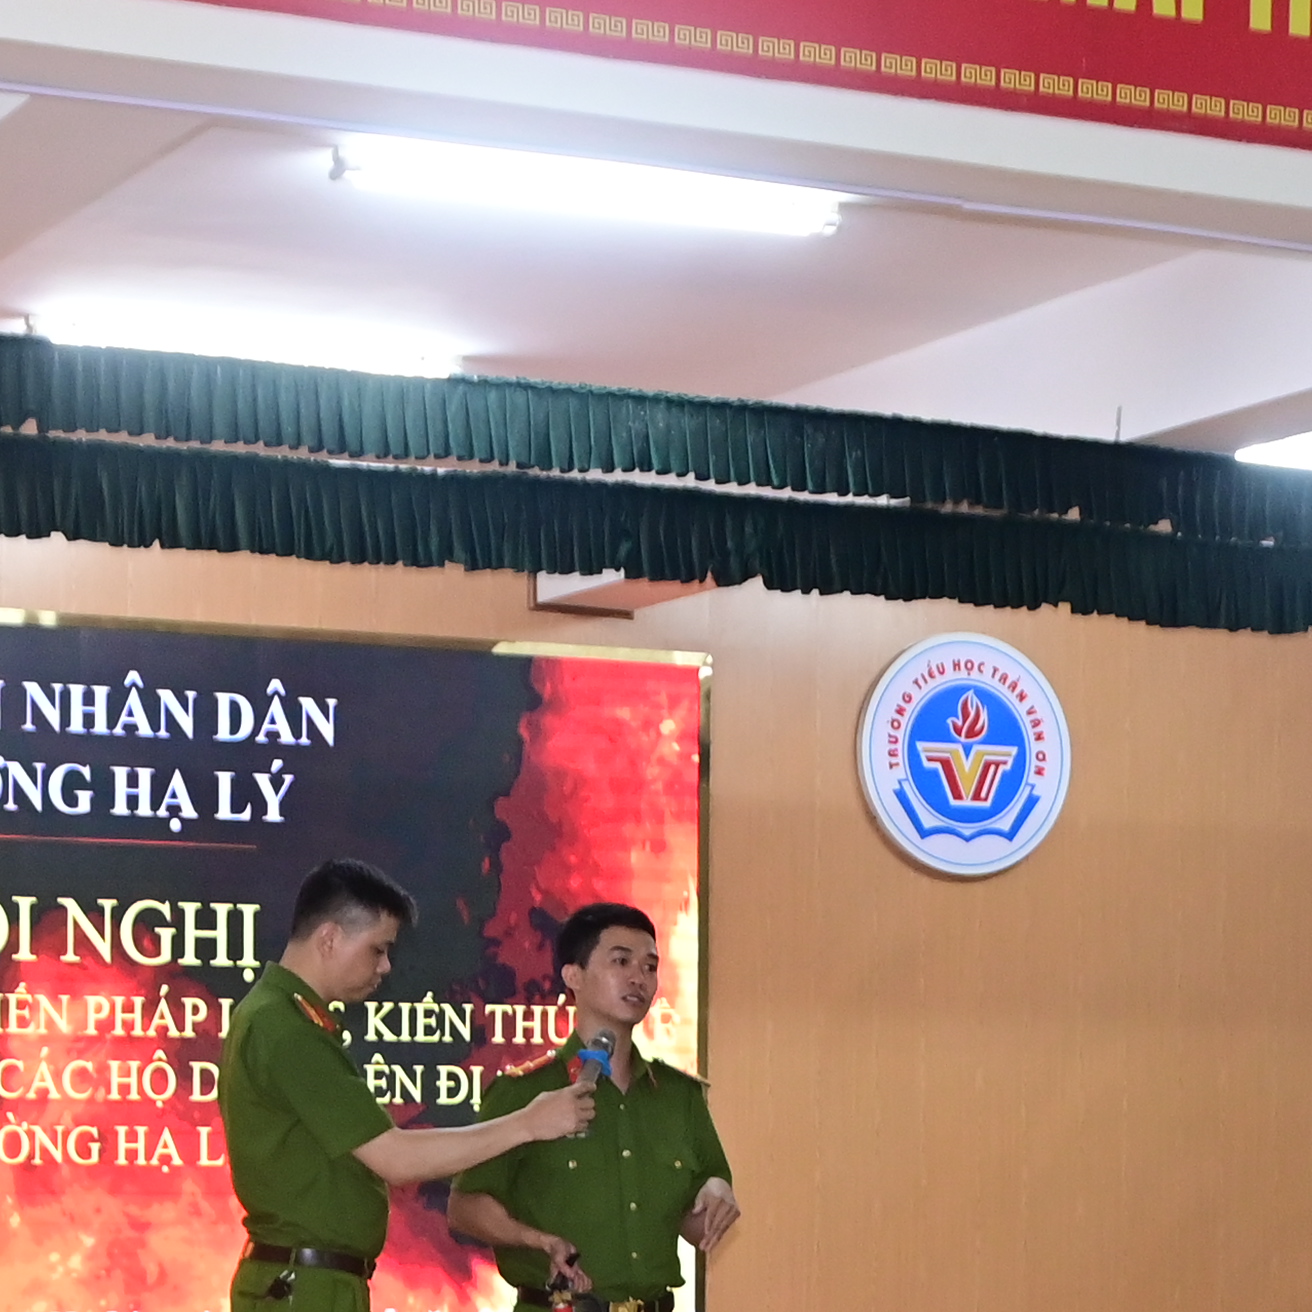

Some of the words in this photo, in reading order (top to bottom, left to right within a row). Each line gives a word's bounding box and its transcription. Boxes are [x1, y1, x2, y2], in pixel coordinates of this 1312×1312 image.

[952, 658, 986, 676] HỌC
[21, 669, 197, 740] NHÂN
[213, 678, 338, 747] DÂN
[109, 765, 199, 833] HẠ
[213, 758, 295, 823] LÝ
[57, 897, 261, 984] NGHỊ
[84, 984, 208, 1039] PHÁP
[363, 991, 475, 1043] KIẾN
[107, 1049, 177, 1108] HỘ
[436, 1064, 485, 1113] ĐỊ
[114, 1126, 184, 1173] HẠ
[196, 1126, 226, 1167] L
